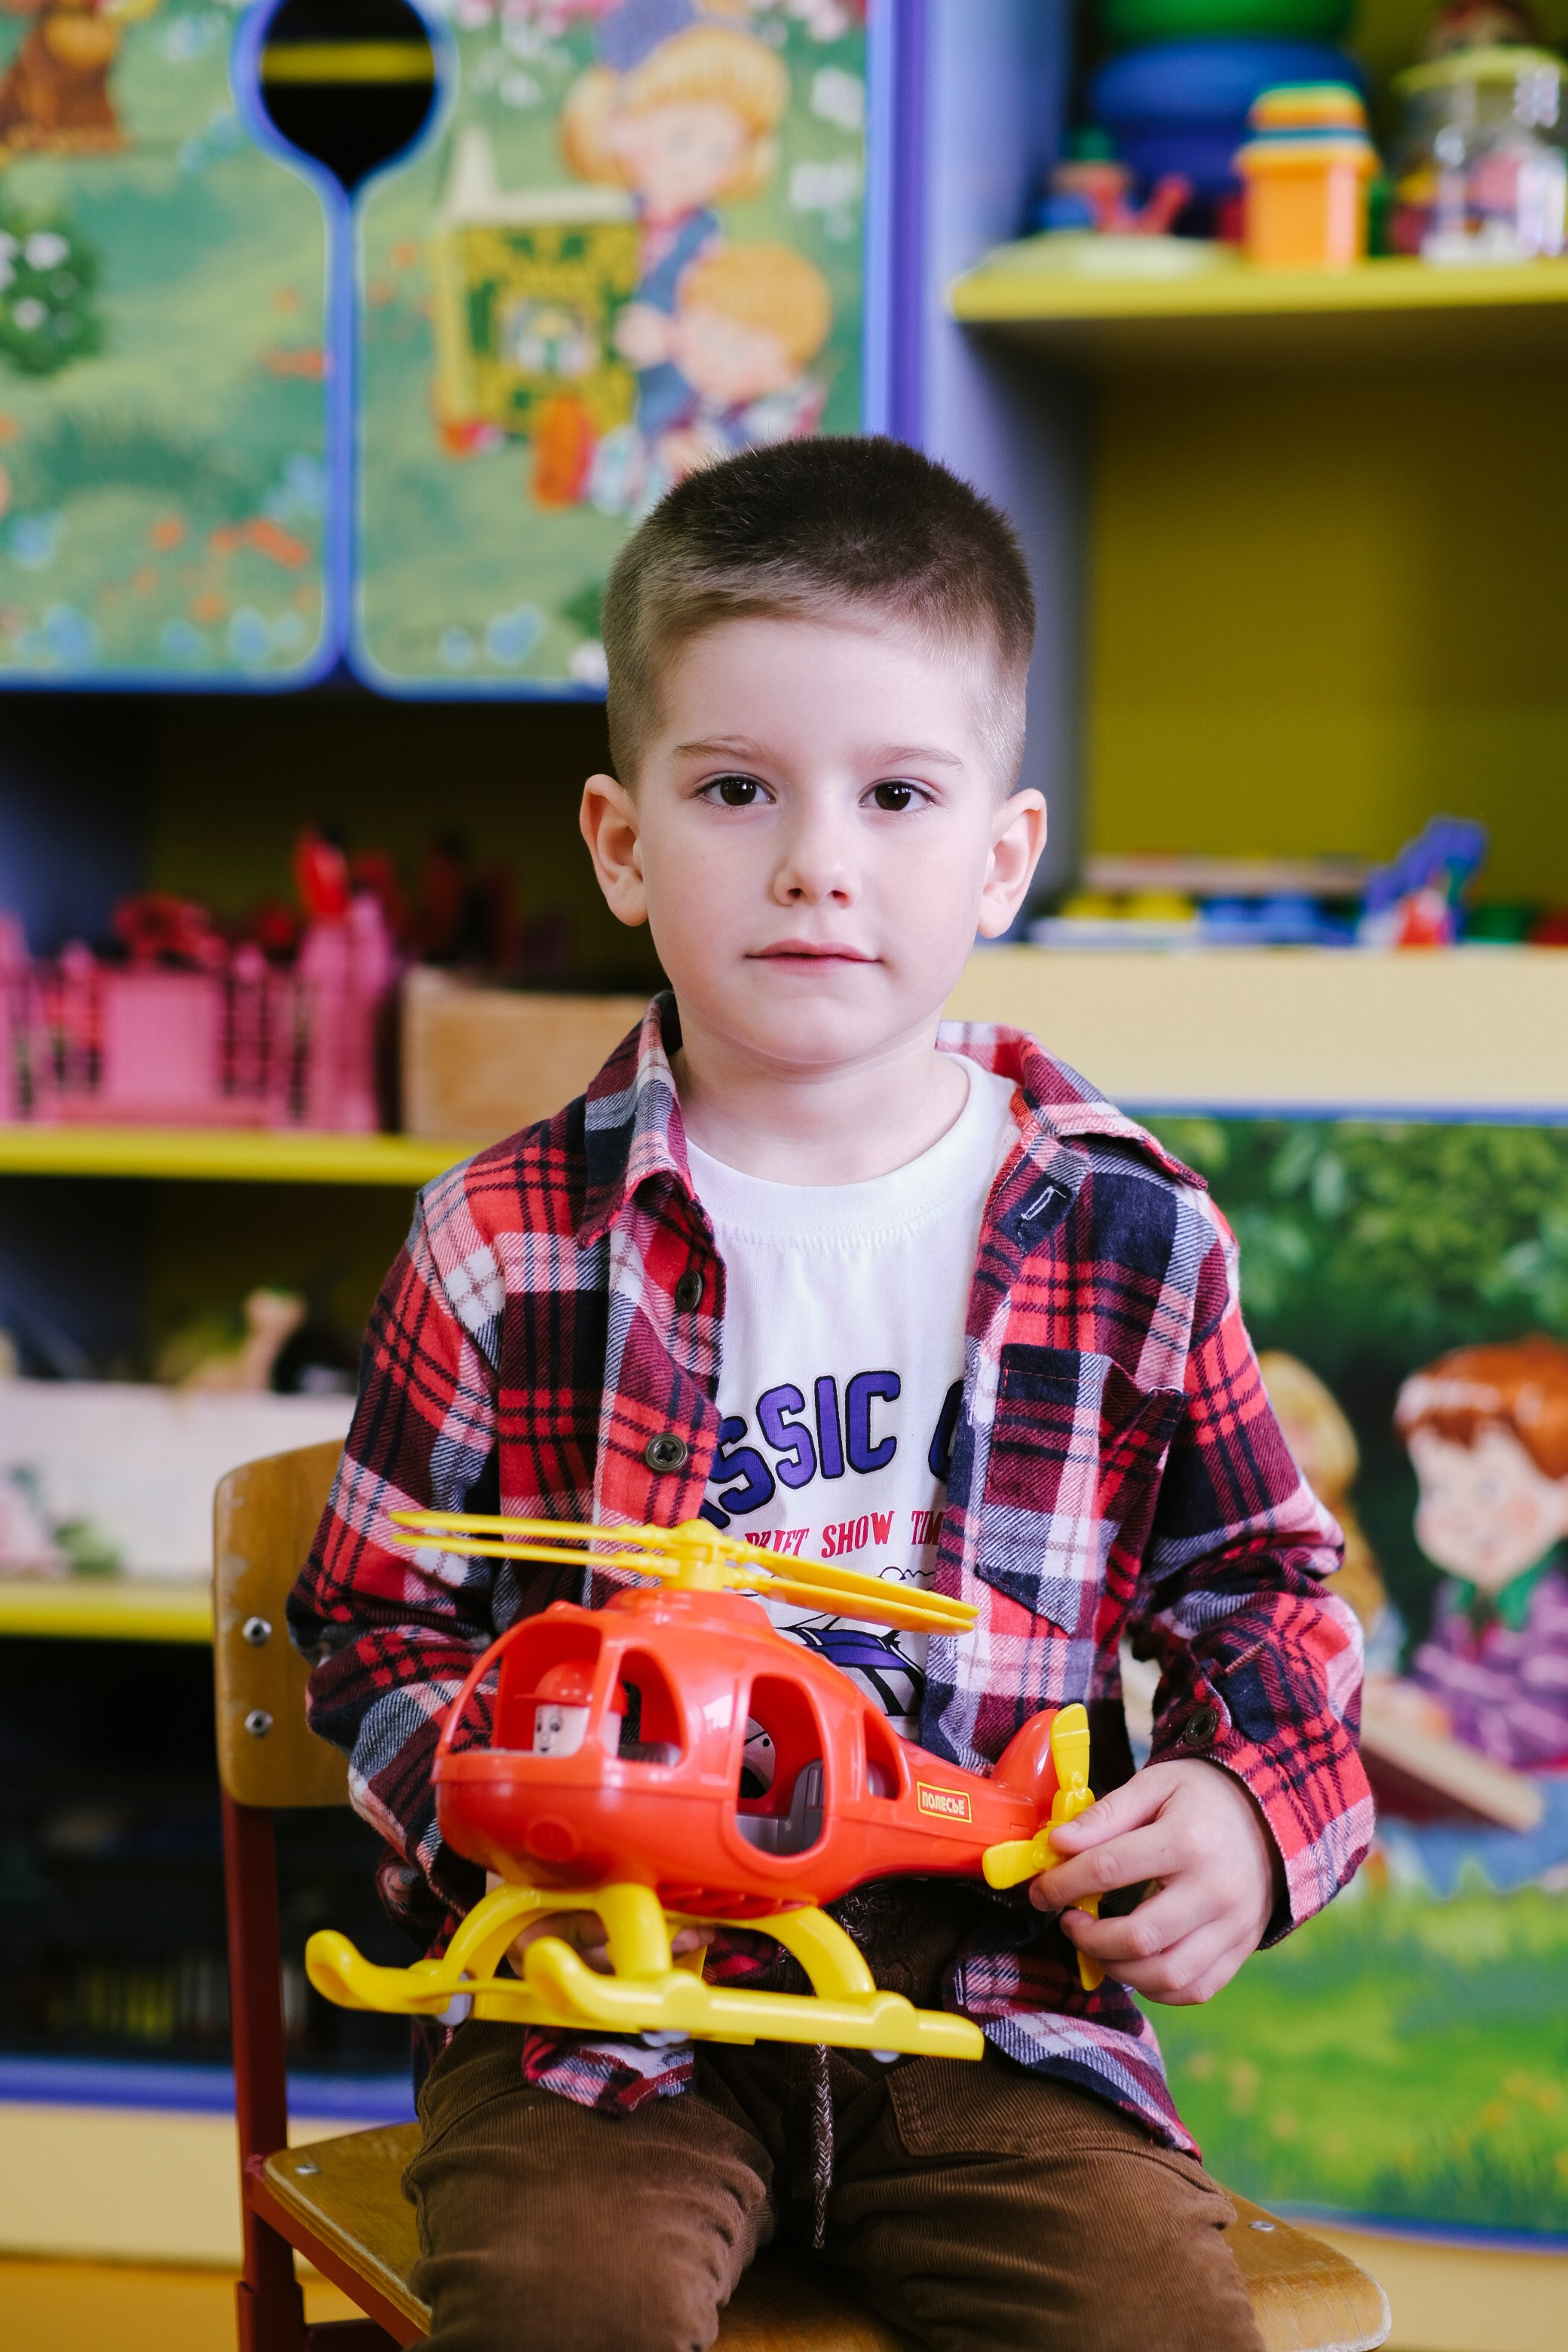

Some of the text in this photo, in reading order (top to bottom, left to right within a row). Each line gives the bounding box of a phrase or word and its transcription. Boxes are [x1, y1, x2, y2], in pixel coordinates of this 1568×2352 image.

[698, 1370, 901, 1530] SSIC
[821, 1510, 896, 1558] SHOW
[921, 1790, 966, 1816] ПОЛЕСЬЕ
